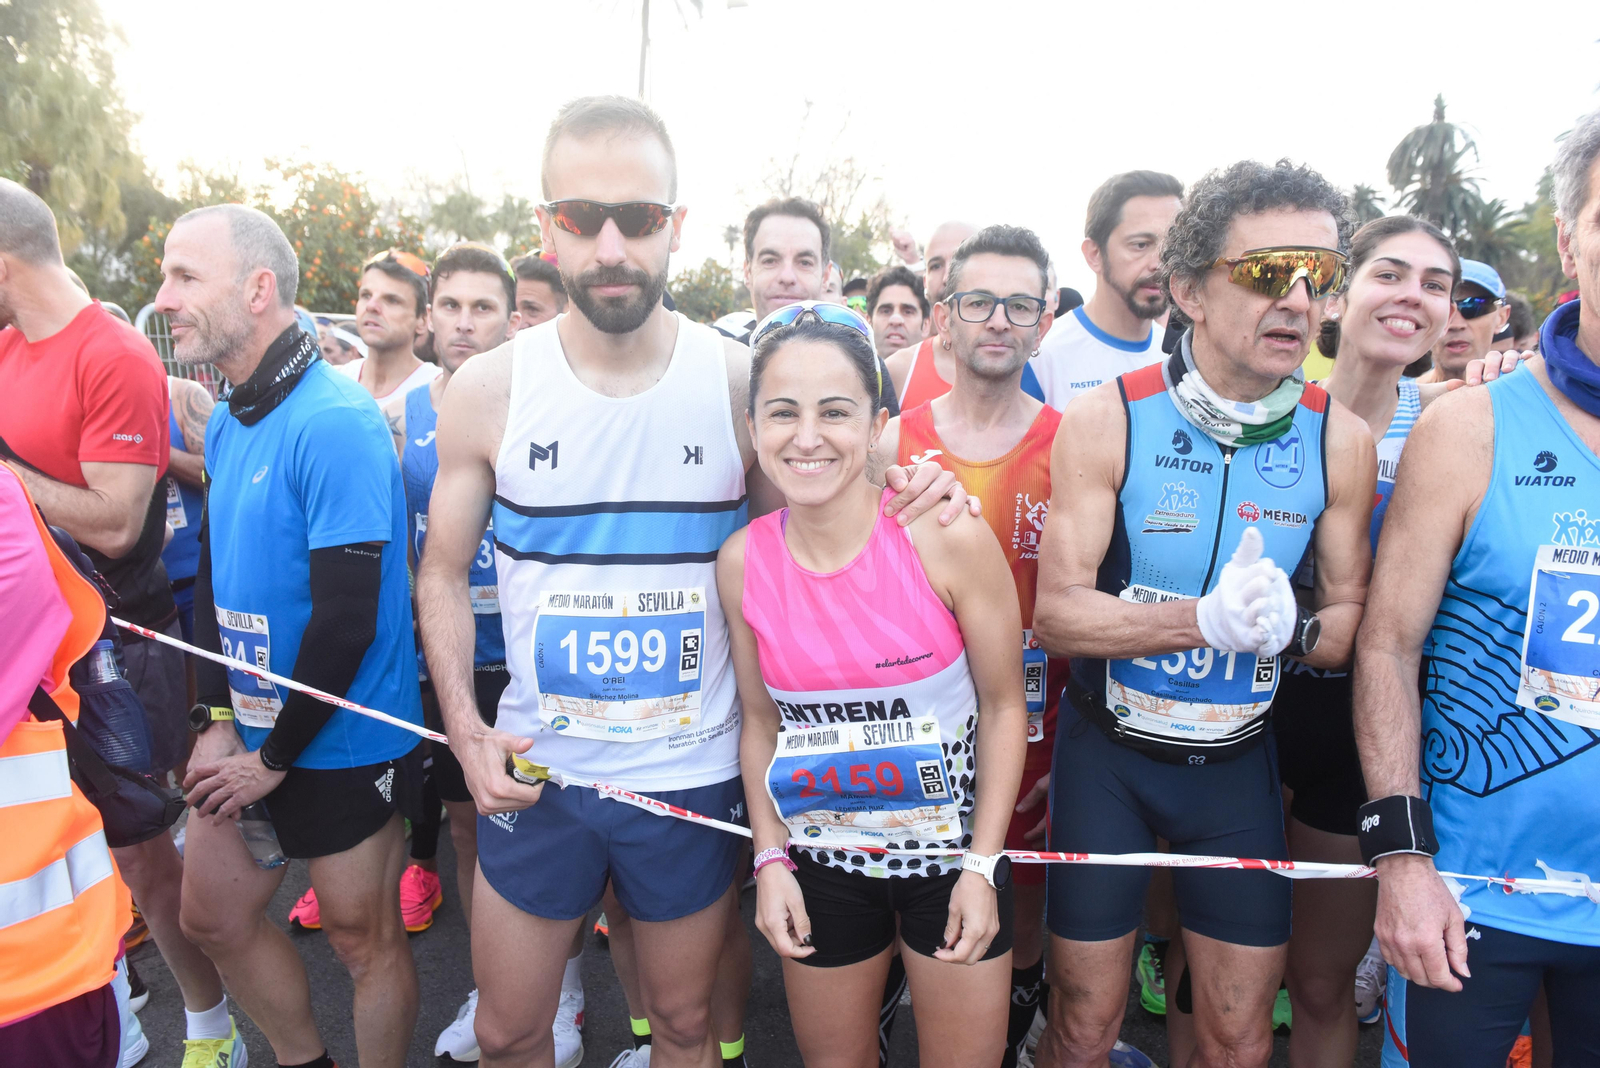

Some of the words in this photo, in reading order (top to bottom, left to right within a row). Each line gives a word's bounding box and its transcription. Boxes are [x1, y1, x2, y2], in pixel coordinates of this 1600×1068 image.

[1155, 455, 1213, 474] VIATOR
[1514, 476, 1576, 487] VIATOR
[1012, 493, 1023, 549] ATLETISMO
[1263, 509, 1308, 524] MÉRIDA
[344, 548, 380, 558] Kalenji
[1552, 549, 1588, 565] MEDIO
[548, 594, 570, 608] MEDIO
[573, 592, 614, 610] MARATÓN
[638, 591, 684, 612] SEVILLA
[1132, 587, 1158, 603] MEDIO
[227, 611, 254, 629] SEVILLA
[219, 632, 249, 675] 34
[560, 629, 667, 674] 1599
[876, 652, 934, 668] #elartedecorrer
[1168, 678, 1200, 688] Casillas
[1151, 690, 1176, 700] Casillas
[774, 698, 911, 724] ENTRENA
[668, 732, 694, 742] Ironman
[696, 723, 724, 737] Lanzarote
[808, 728, 839, 748] MARATÓN
[863, 722, 914, 746] SEVILLA
[1170, 723, 1195, 731] HOKA
[668, 740, 696, 750] Maratón
[708, 730, 723, 740] Sevilla
[386, 768, 394, 802] adidas
[792, 761, 904, 798] 2159
